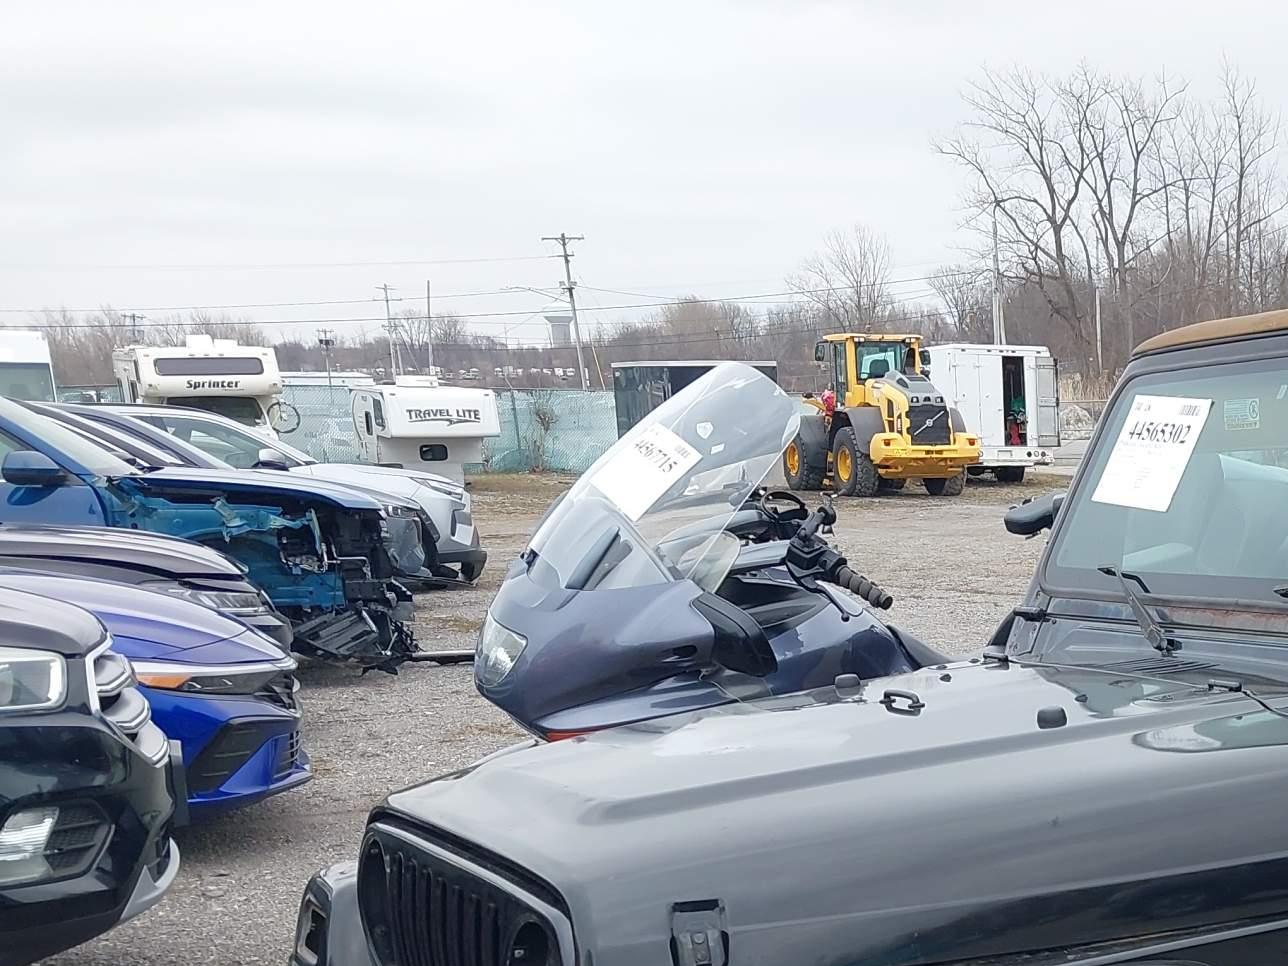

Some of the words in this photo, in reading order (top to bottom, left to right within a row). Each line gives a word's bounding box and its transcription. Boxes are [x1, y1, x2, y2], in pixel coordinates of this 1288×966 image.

[186, 379, 241, 391] Sprinter
[406, 409, 453, 420] TRAVEL
[456, 409, 481, 420] LITE
[1129, 421, 1192, 444] 44565302
